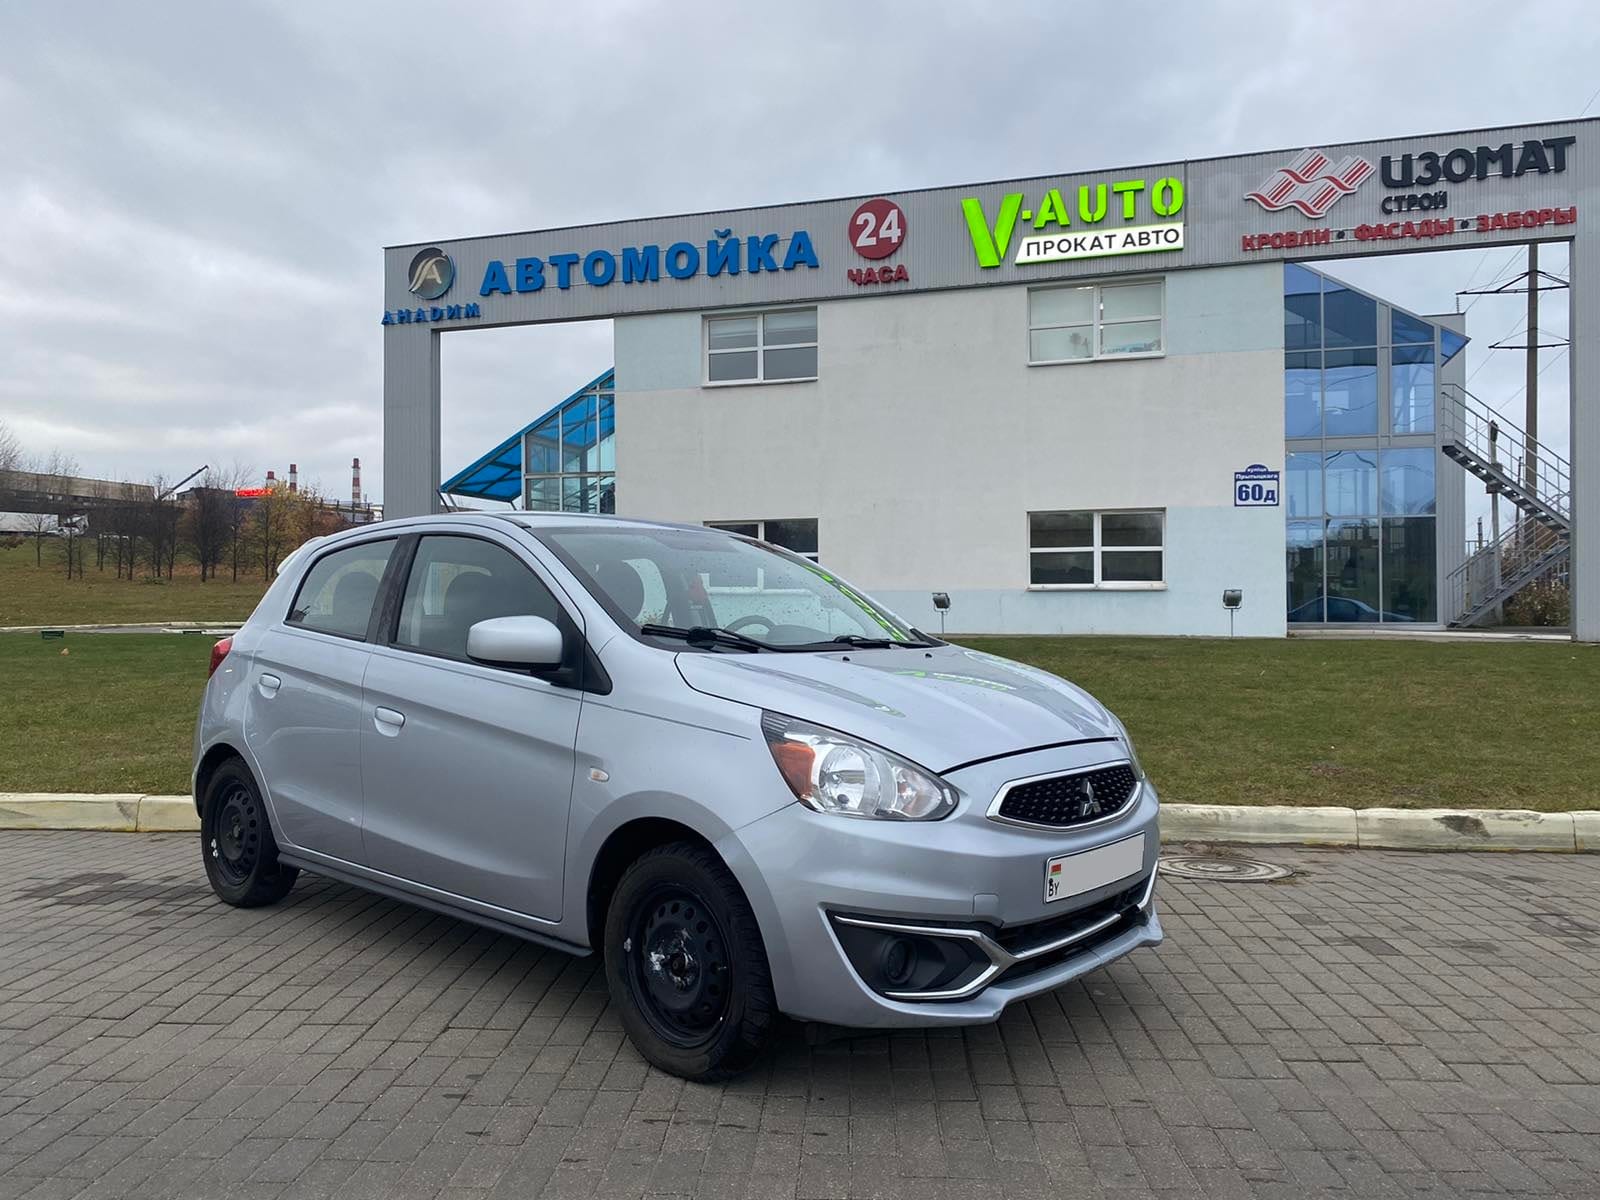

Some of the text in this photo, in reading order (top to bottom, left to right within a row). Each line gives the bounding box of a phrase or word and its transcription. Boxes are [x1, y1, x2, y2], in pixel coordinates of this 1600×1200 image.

[1381, 191, 1448, 215] СТРОЙ
[856, 209, 902, 247] 24
[961, 177, 1185, 267] V-AUTO
[1242, 206, 1577, 251] КРОВЛИ ФАСАДЫ ЗАБОРЫ
[1026, 228, 1180, 257] ПРОКАТ АВТО
[480, 228, 819, 297] АВТОМОЙКА
[847, 264, 909, 286] ЧАСА
[1048, 879, 1060, 896] BY
